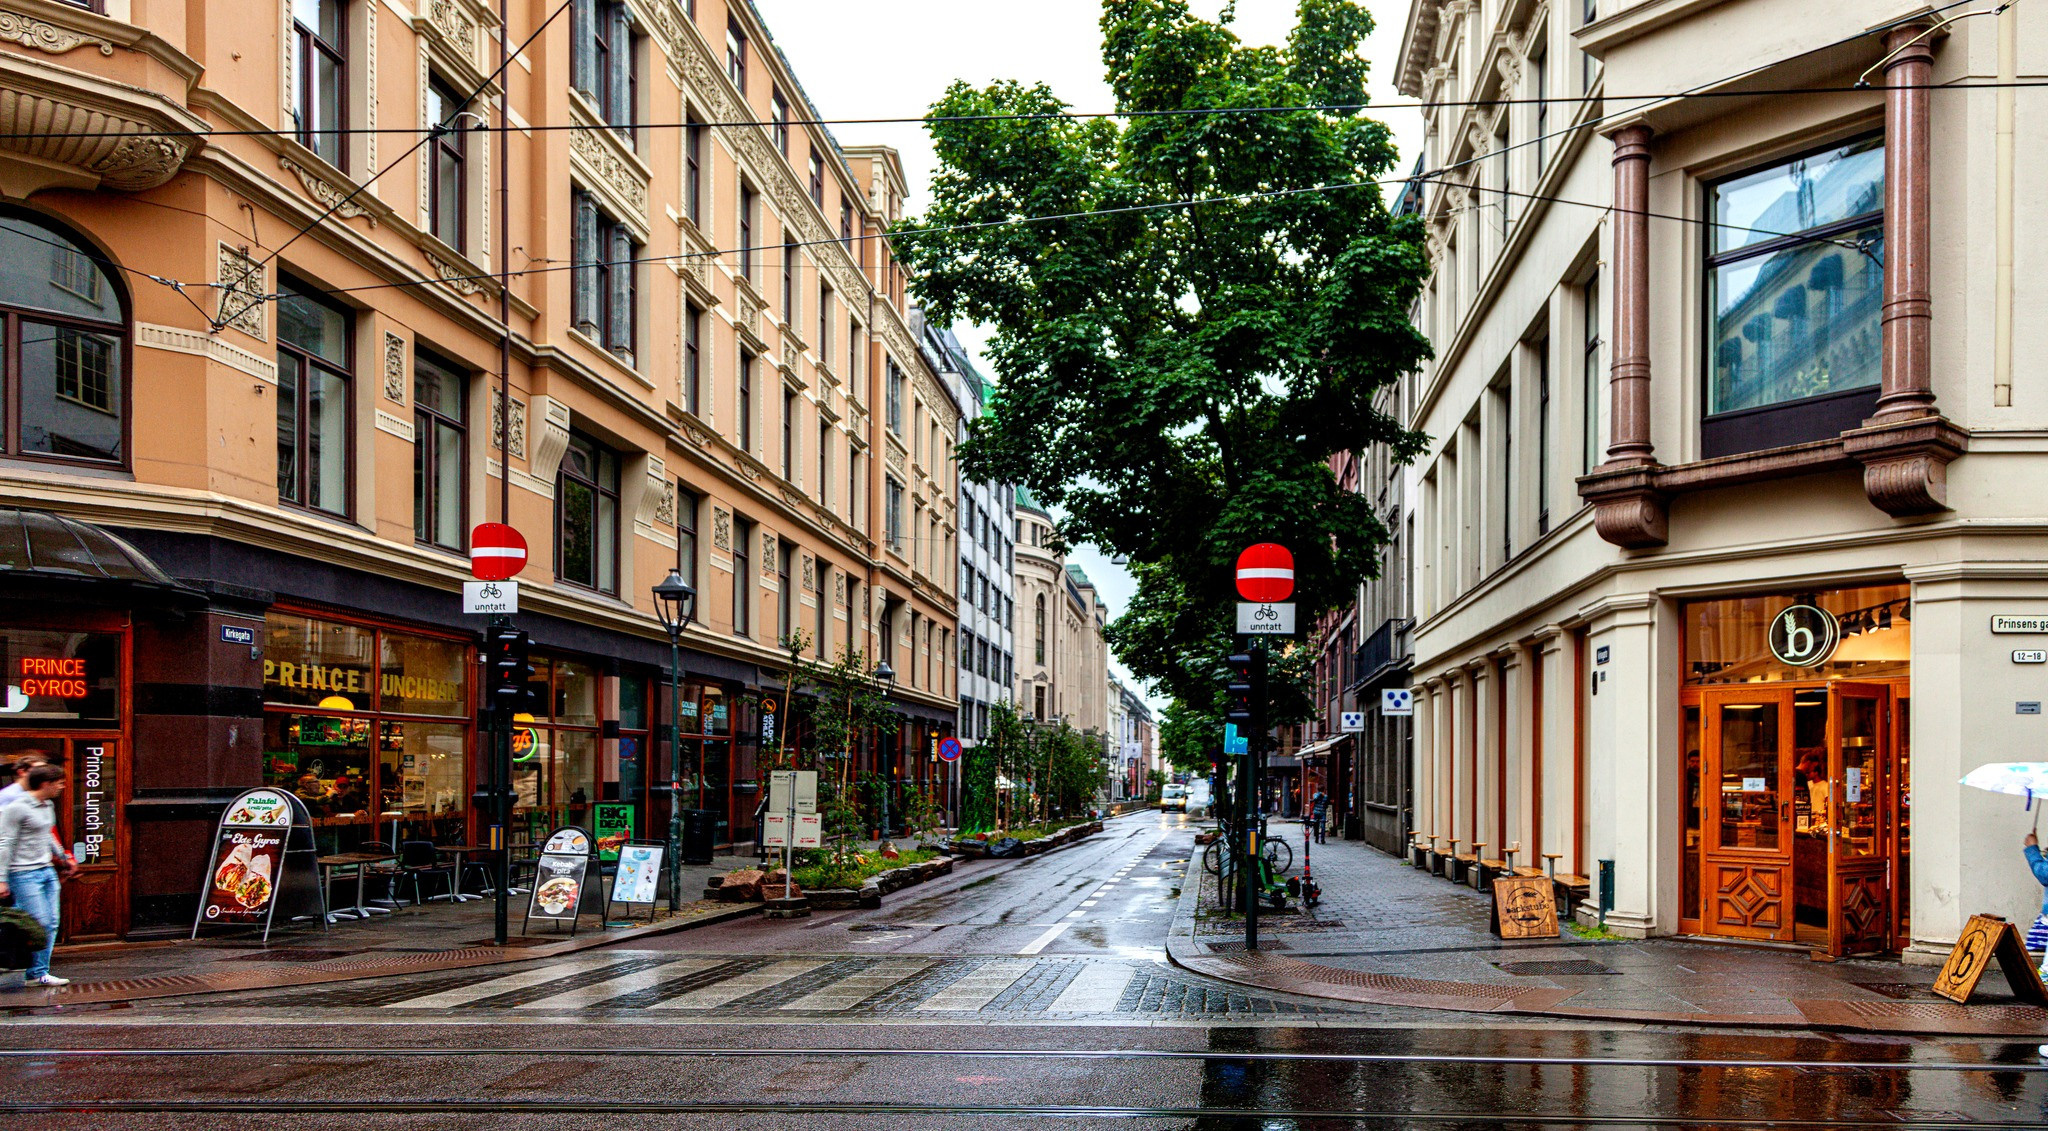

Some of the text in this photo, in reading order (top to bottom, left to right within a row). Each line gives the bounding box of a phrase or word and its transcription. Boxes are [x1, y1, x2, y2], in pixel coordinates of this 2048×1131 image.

[474, 603, 506, 611] unntatt
[1250, 622, 1282, 631] unntatt
[1998, 618, 2037, 629] Prinsens
[23, 658, 86, 676] PRINCE
[264, 659, 458, 701] PRINCE UNCHBAR
[23, 678, 86, 697] GYROS
[86, 747, 104, 857] Prince Lunch Bar
[246, 797, 278, 805] Falafel
[600, 807, 627, 819] BIG
[231, 833, 252, 844] Ekte
[252, 834, 280, 848] Gyros
